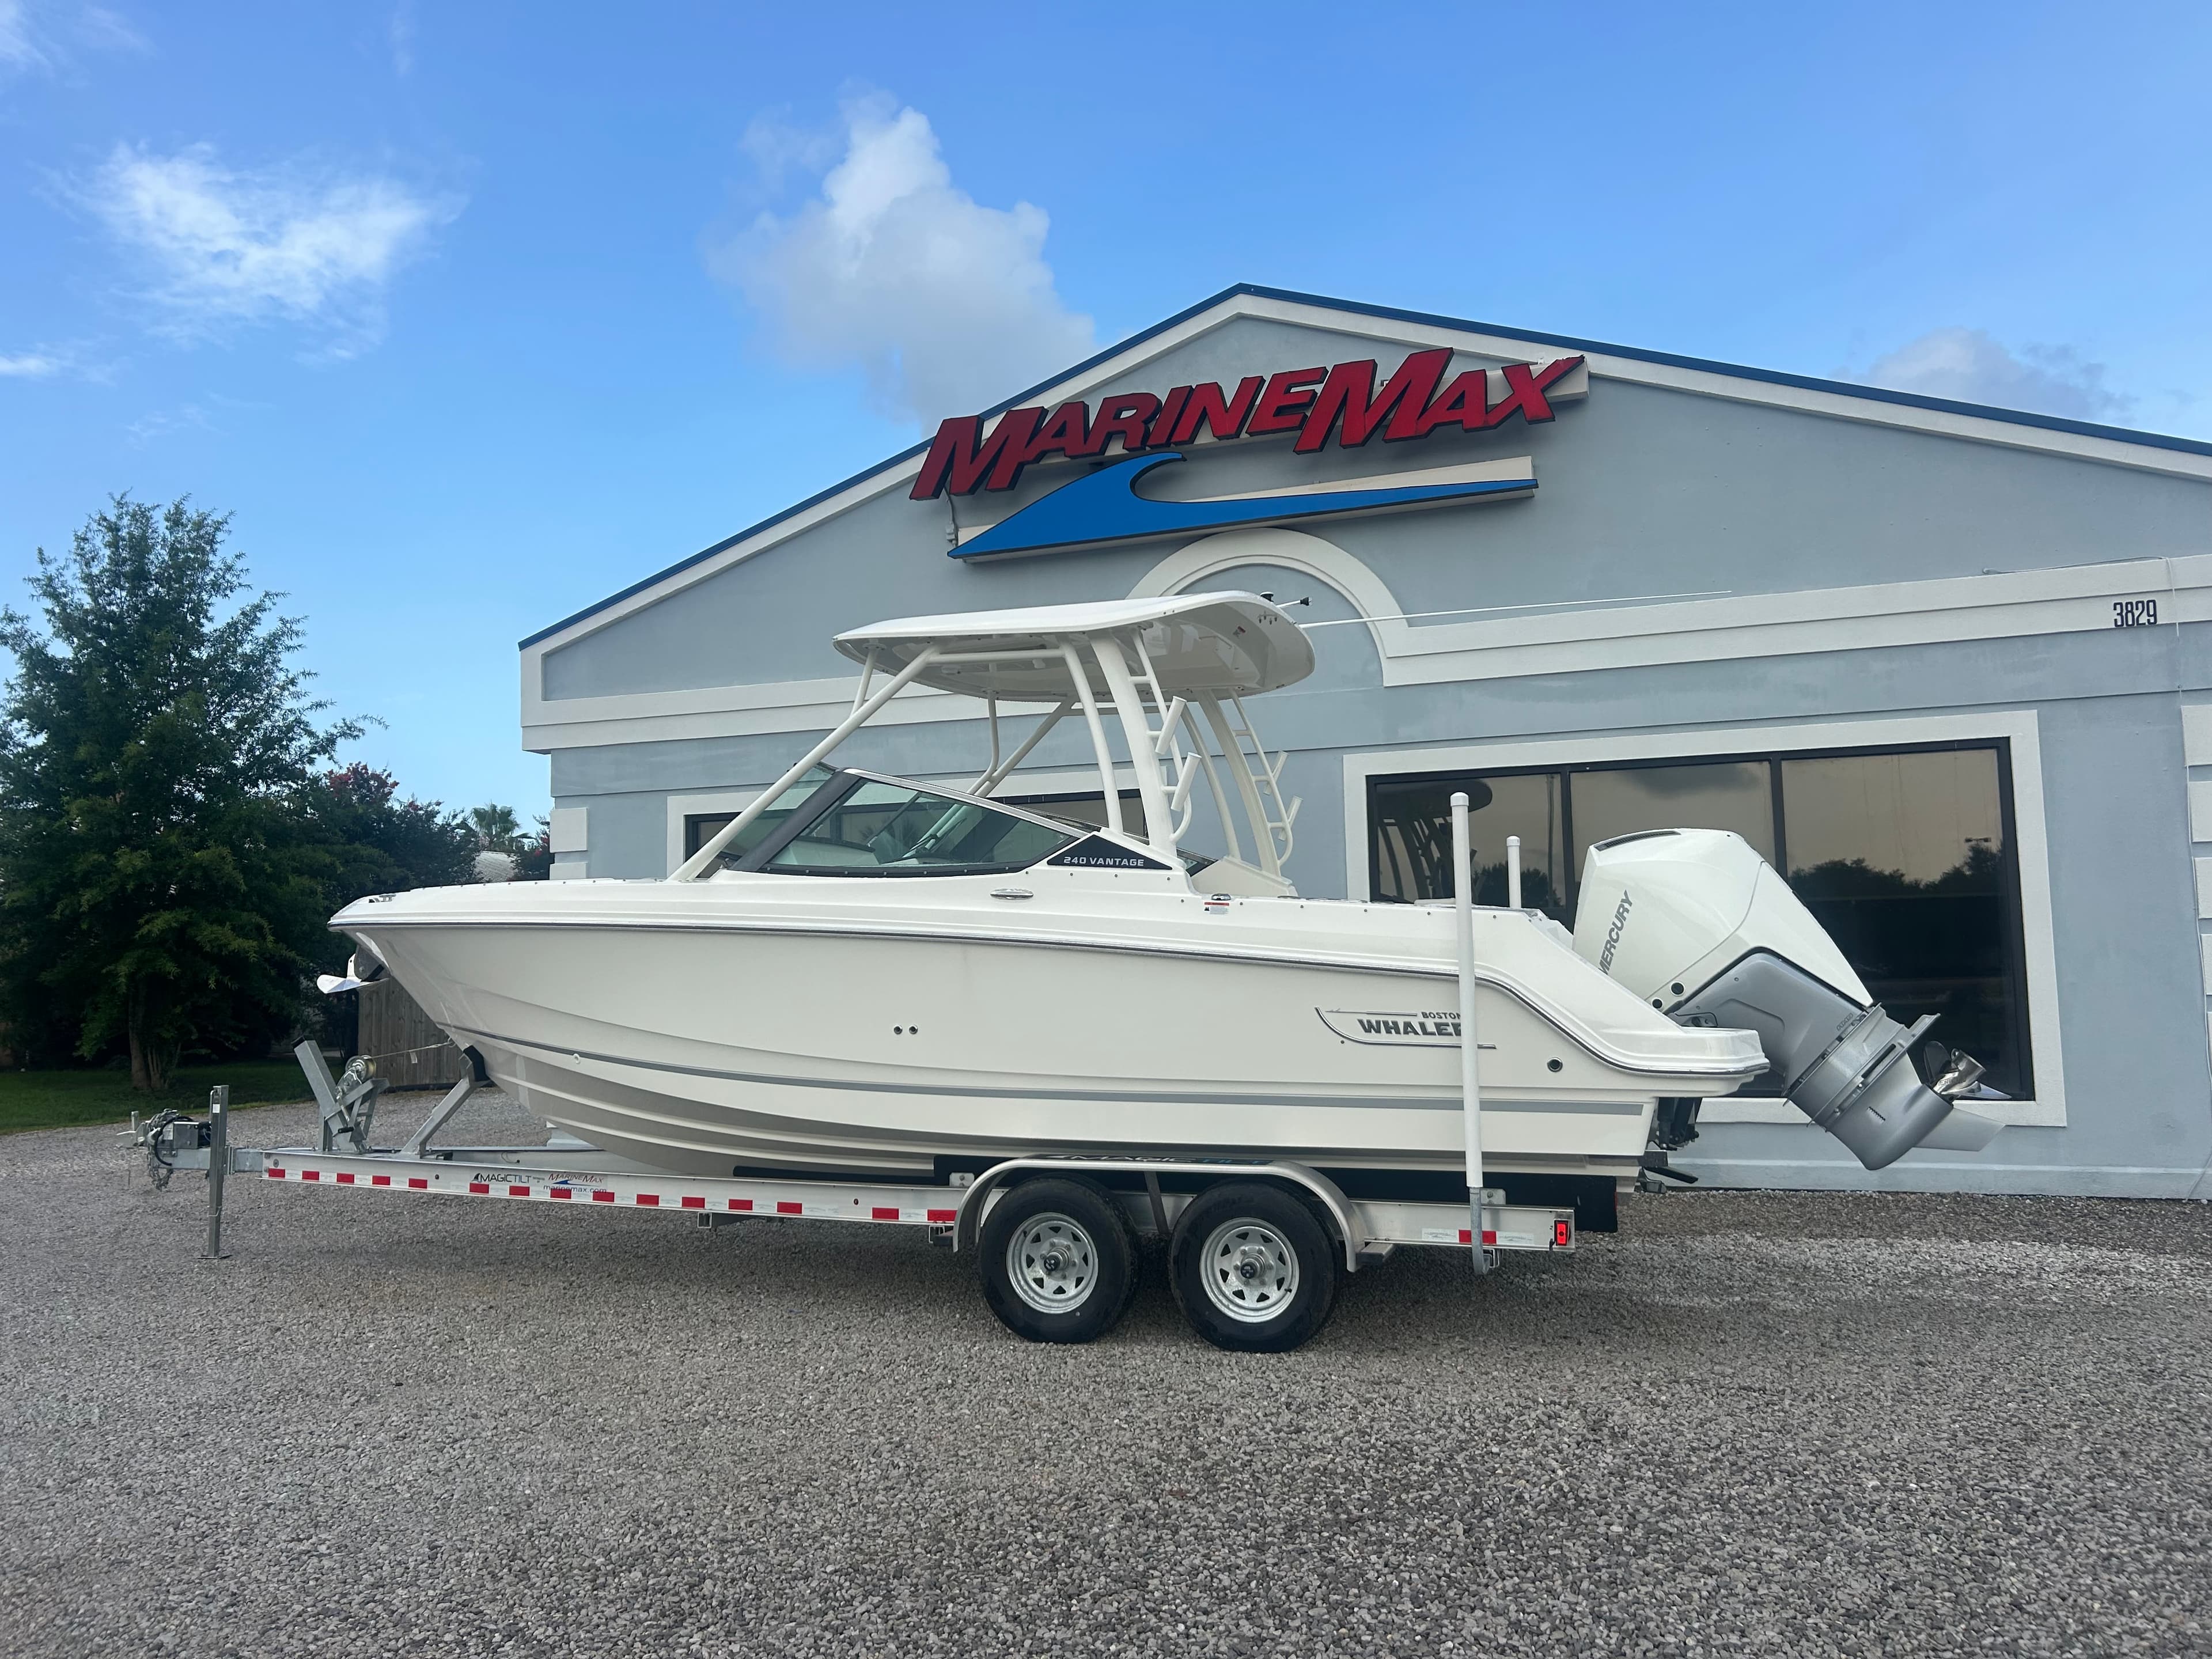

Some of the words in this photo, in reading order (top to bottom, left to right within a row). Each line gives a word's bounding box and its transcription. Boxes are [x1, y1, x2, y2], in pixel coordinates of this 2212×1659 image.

[2113, 599, 2158, 627] 3829
[1089, 857, 1145, 866] VANTAGE
[1598, 889, 1633, 975] MERCURY
[1421, 1012, 1461, 1020] BOSTON
[543, 1184, 607, 1193] marinemax.com
